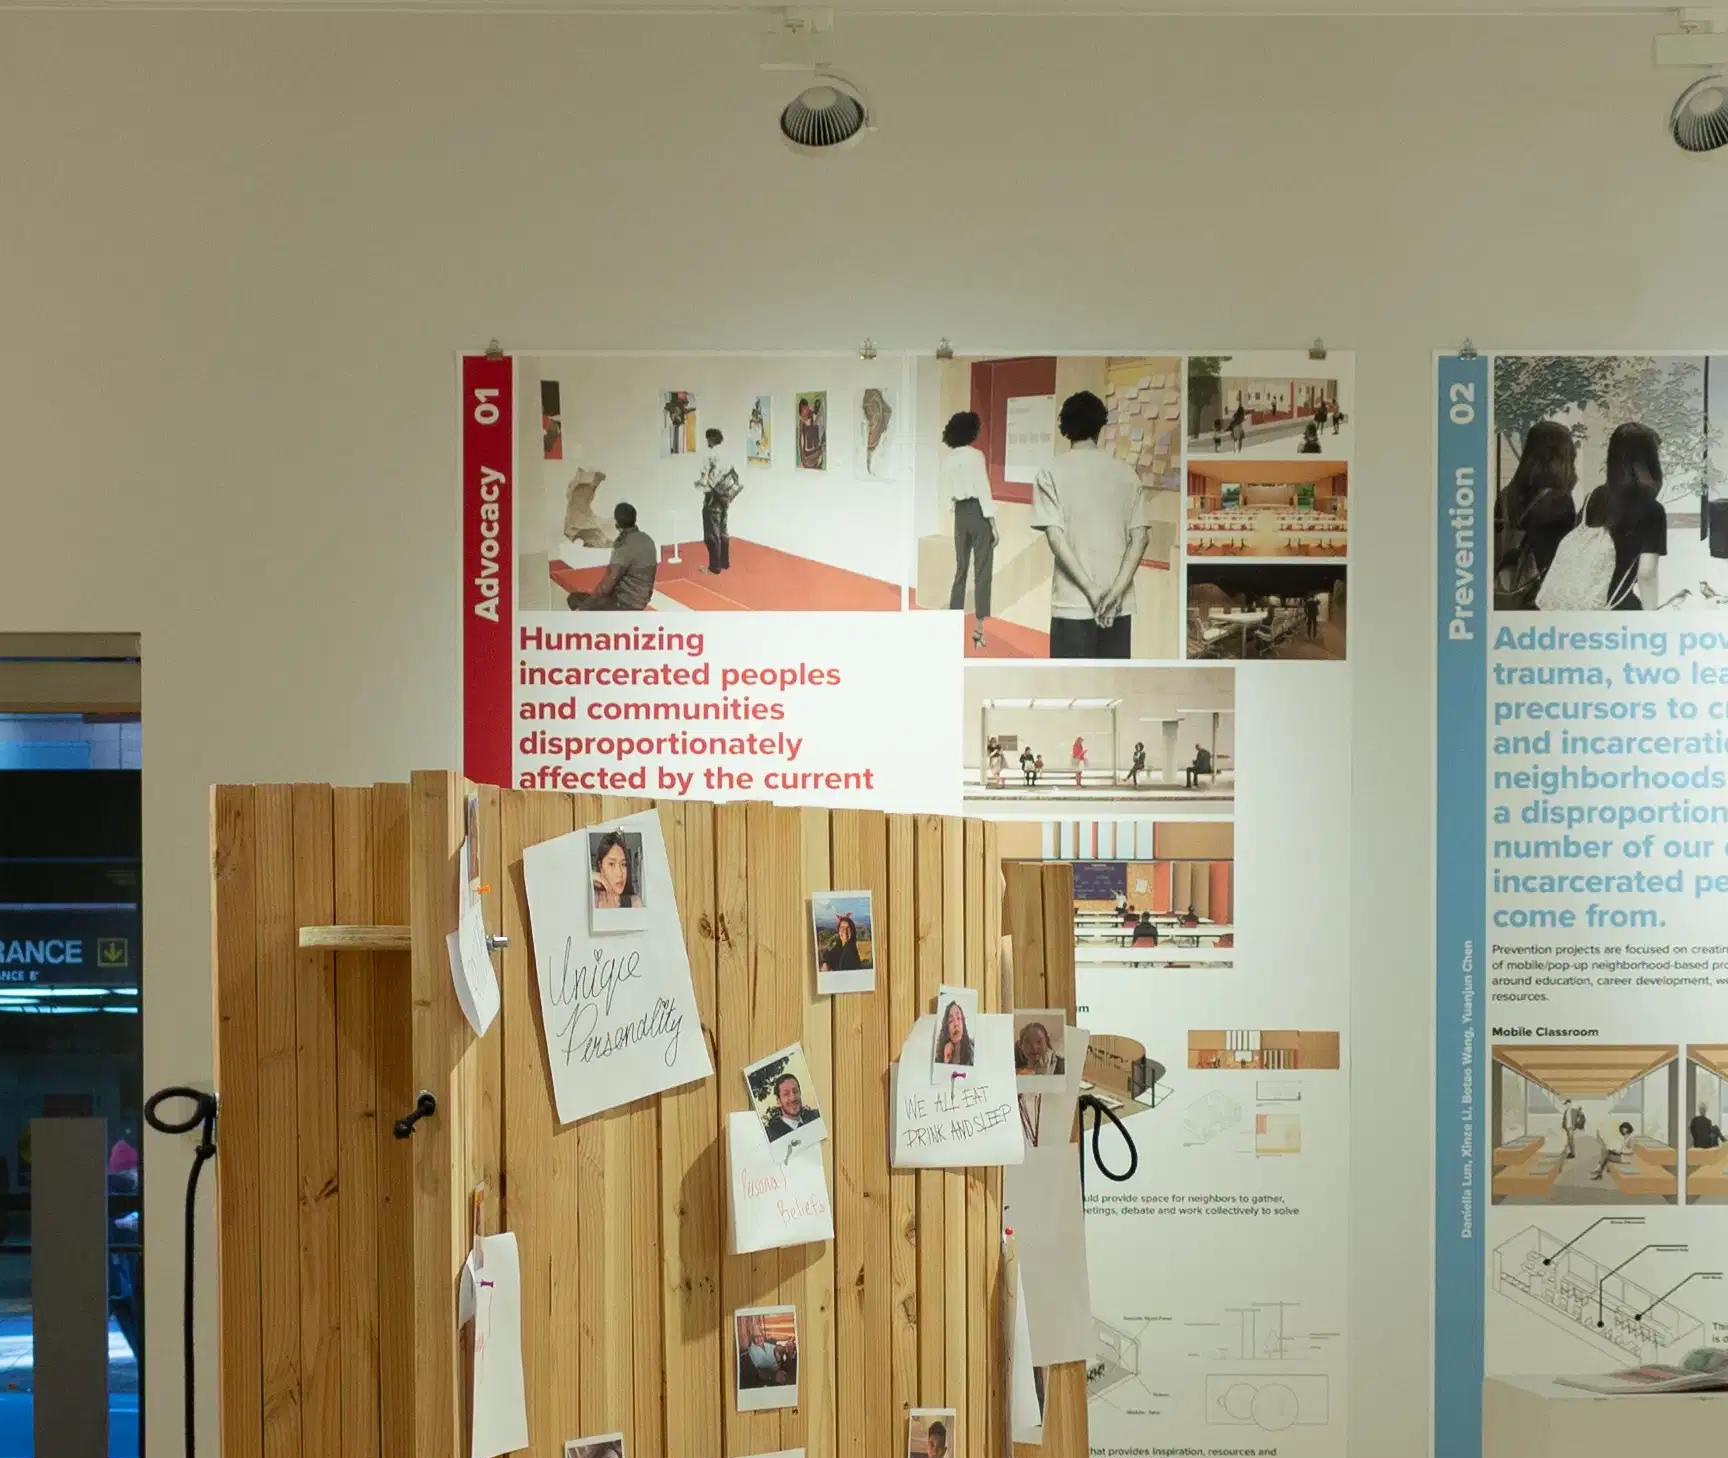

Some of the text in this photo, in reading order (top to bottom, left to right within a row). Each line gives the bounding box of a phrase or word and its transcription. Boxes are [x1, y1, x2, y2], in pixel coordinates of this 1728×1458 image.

[475, 389, 500, 425] 01
[1449, 382, 1475, 424] 02
[475, 466, 506, 623] Advocacy
[1449, 467, 1475, 640] Prevention
[521, 627, 704, 657] Humanizing
[1494, 626, 1668, 657] Addressing
[520, 661, 841, 692] incarcerated peoples
[1493, 663, 1613, 689] trauma,
[1623, 663, 1681, 685] two
[520, 696, 785, 721] and communities
[1495, 702, 1657, 726] precursors
[1667, 698, 1698, 720] to
[520, 730, 803, 762] disproportionately
[1494, 731, 1551, 755] and
[520, 766, 874, 796] affected by the current
[1494, 764, 1726, 796] neighborhoods
[1493, 805, 1511, 825] a
[1494, 835, 1614, 859] number
[1623, 835, 1656, 859] of
[1664, 840, 1714, 859] our
[1494, 868, 1683, 894] incarcerated
[1493, 904, 1667, 929] come from.
[548, 936, 642, 1016] Unique
[556, 997, 684, 1068] Personality
[1491, 1026, 1600, 1040] Mobile Classroom
[905, 1094, 928, 1120] WE
[961, 1085, 989, 1109] EAT
[903, 1103, 1012, 1148] DRINK AND SLEEP
